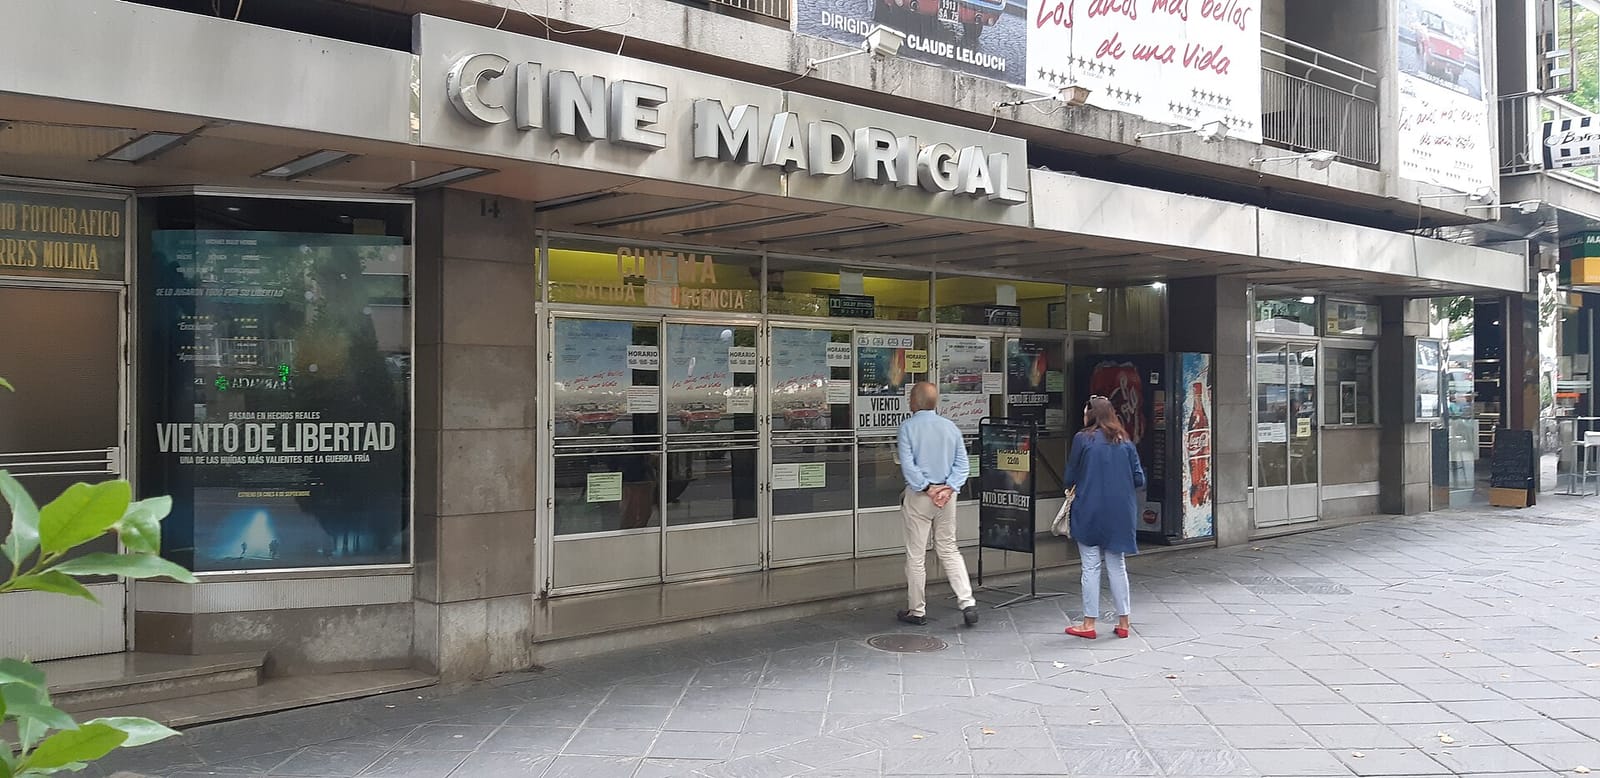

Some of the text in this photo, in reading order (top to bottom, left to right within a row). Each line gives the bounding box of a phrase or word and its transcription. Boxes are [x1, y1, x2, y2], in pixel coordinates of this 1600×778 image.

[907, 34, 954, 59] CLAUDE
[956, 46, 1007, 72] LELOUCH
[1095, 31, 1126, 59] de
[1132, 43, 1174, 64] una
[446, 53, 1027, 203] CINE MADRIGAL
[22, 204, 120, 237] FOTOGRAFICO
[43, 241, 100, 270] MOLINA
[617, 246, 717, 284] CINEMA
[576, 280, 637, 303] SALIDA
[671, 286, 745, 310] URGENCIA
[228, 411, 320, 420] BASADA EN HECHOS REALES
[870, 397, 900, 411] VIENTO
[859, 413, 871, 427] DE
[156, 422, 396, 453] VIENTO DE LIBERTAD
[196, 456, 205, 464] DE
[206, 456, 219, 464] LAS
[248, 453, 265, 464] MÁS
[265, 455, 302, 464] VALIENTES
[304, 455, 313, 463] DE
[315, 455, 324, 463] LA
[325, 455, 352, 463] GUERRA
[354, 453, 370, 463] FRÍA
[997, 493, 1008, 505] DE
